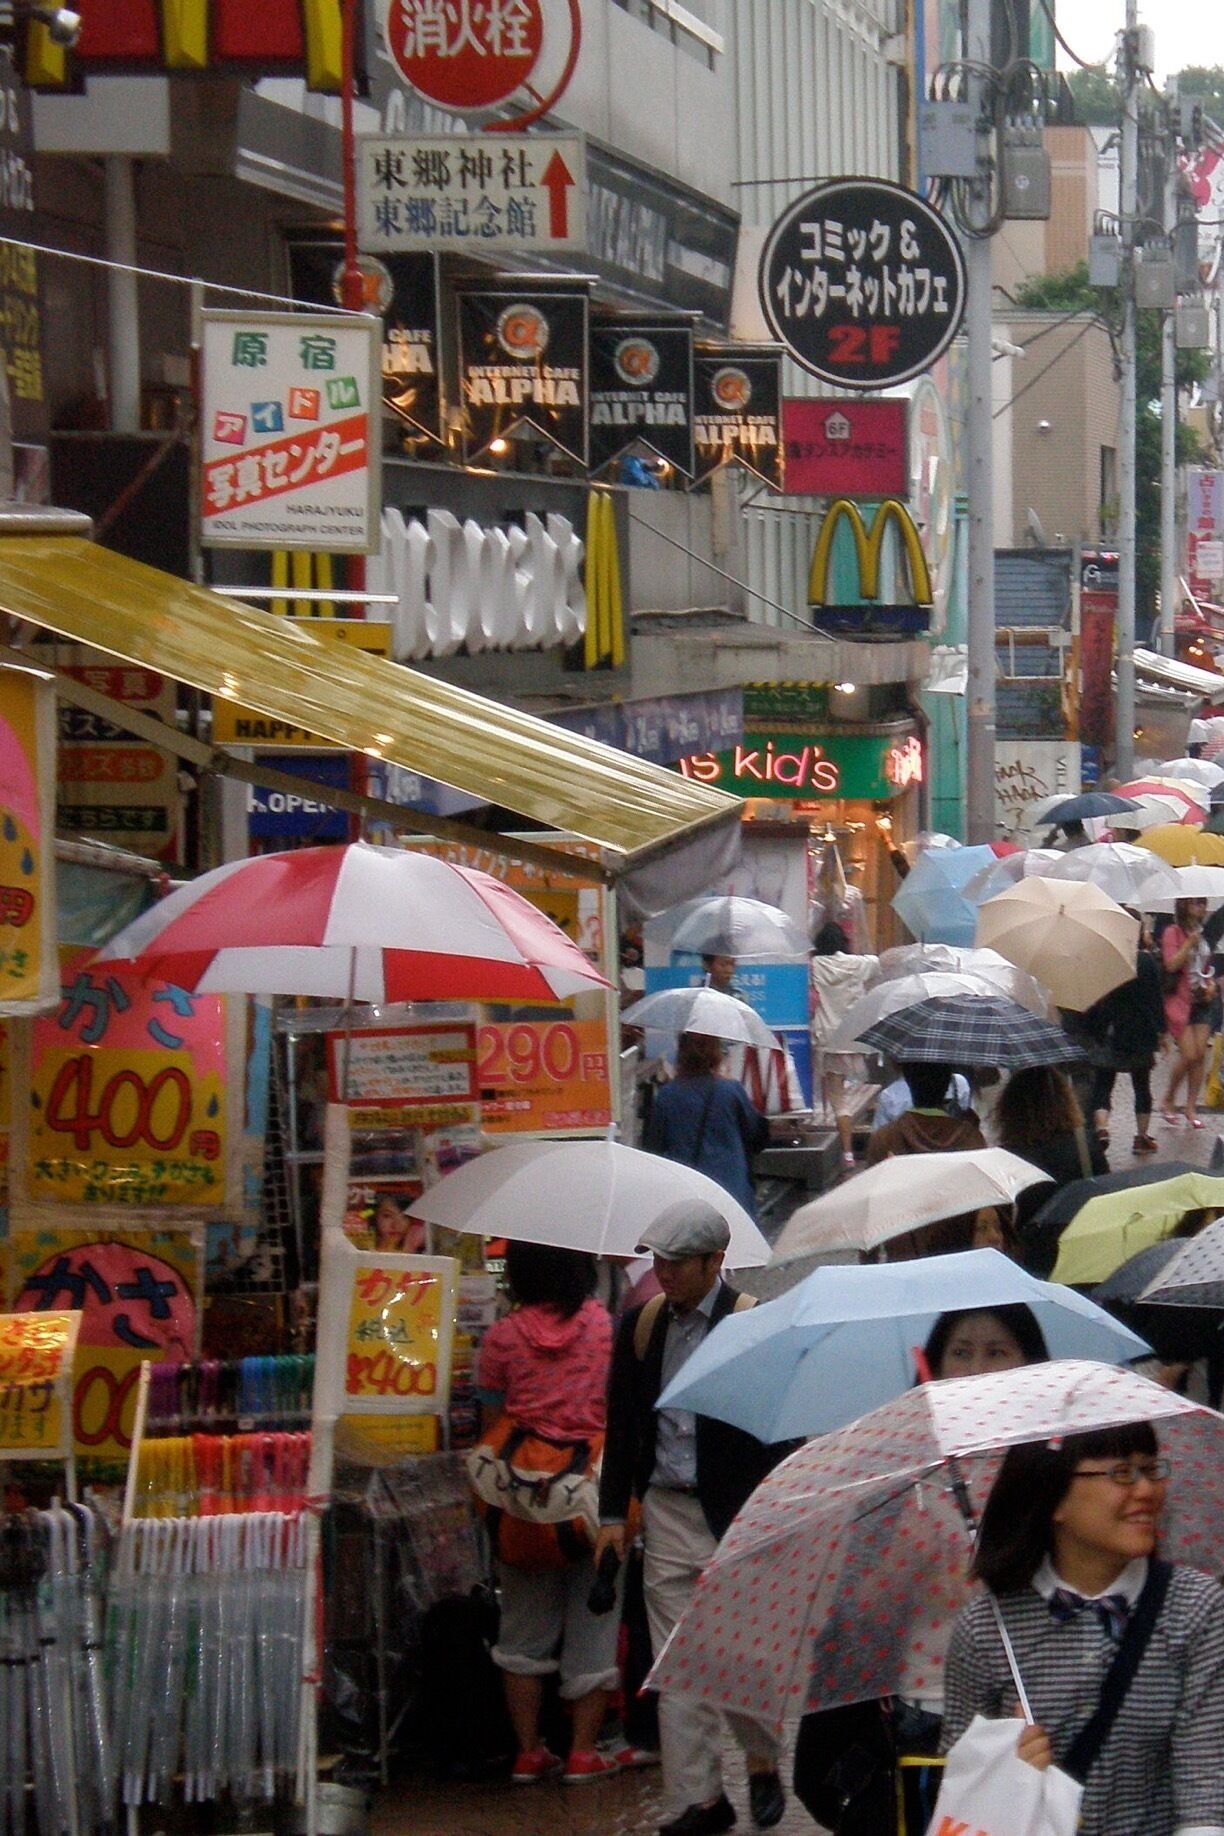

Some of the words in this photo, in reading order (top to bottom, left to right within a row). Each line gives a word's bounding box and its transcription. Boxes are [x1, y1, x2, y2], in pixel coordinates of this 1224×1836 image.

[401, 0, 533, 58] 消火栓
[374, 148, 536, 191] 東郷神社
[374, 195, 536, 238] 東郷記念館
[799, 218, 890, 263] コミック
[899, 218, 921, 260] &
[776, 263, 949, 319] インターネットカフェ
[231, 331, 337, 370] 原宿
[826, 324, 900, 364] 2F
[214, 377, 359, 444] アイドル
[469, 378, 581, 406] ALPHA
[591, 402, 688, 425] ALPHA
[693, 425, 778, 445] ALPHA
[207, 431, 365, 508] 写真センター
[212, 519, 238, 531] IDOL
[241, 520, 318, 534] PHOTOGRAPH
[320, 523, 364, 536] CENTER
[286, 503, 363, 517] HARAJYUKU
[734, 740, 841, 792] kid's
